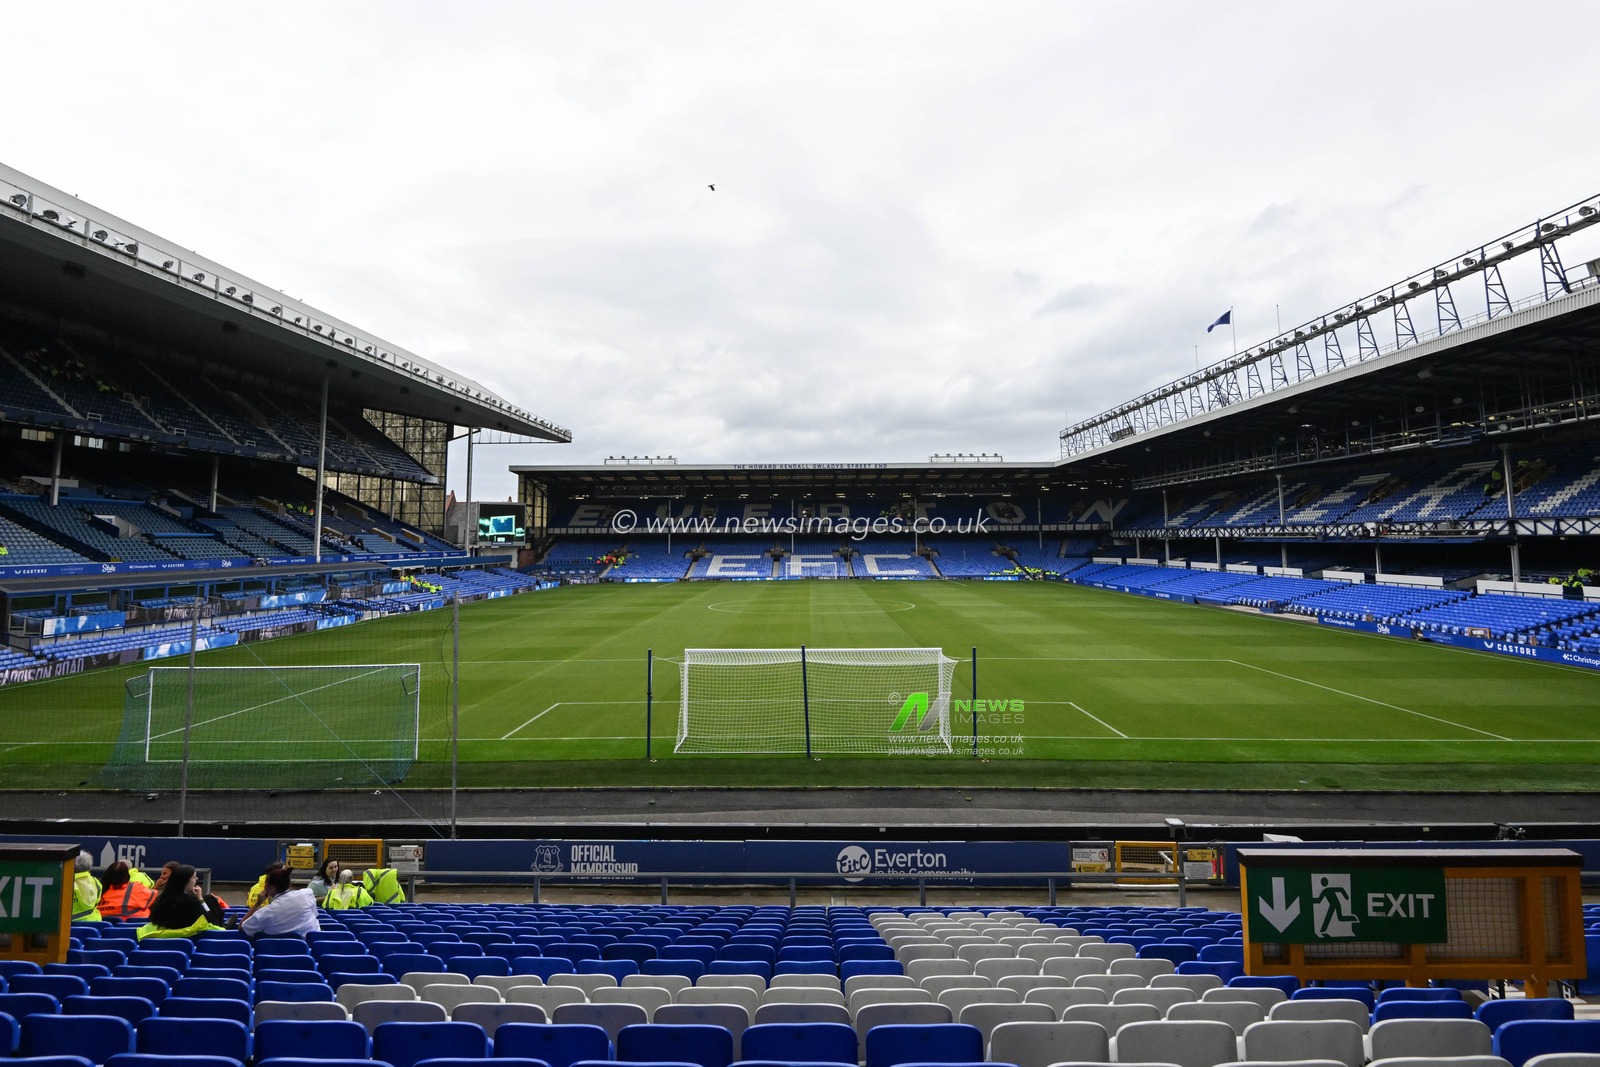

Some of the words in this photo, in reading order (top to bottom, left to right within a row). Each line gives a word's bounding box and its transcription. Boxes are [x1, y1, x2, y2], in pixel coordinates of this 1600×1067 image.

[1497, 643, 1537, 657] CASTORE
[570, 845, 616, 862] OFFICIAL
[874, 848, 947, 868] Everton
[570, 862, 638, 880] MEMBERSHIP
[1367, 893, 1435, 918] EXIT
